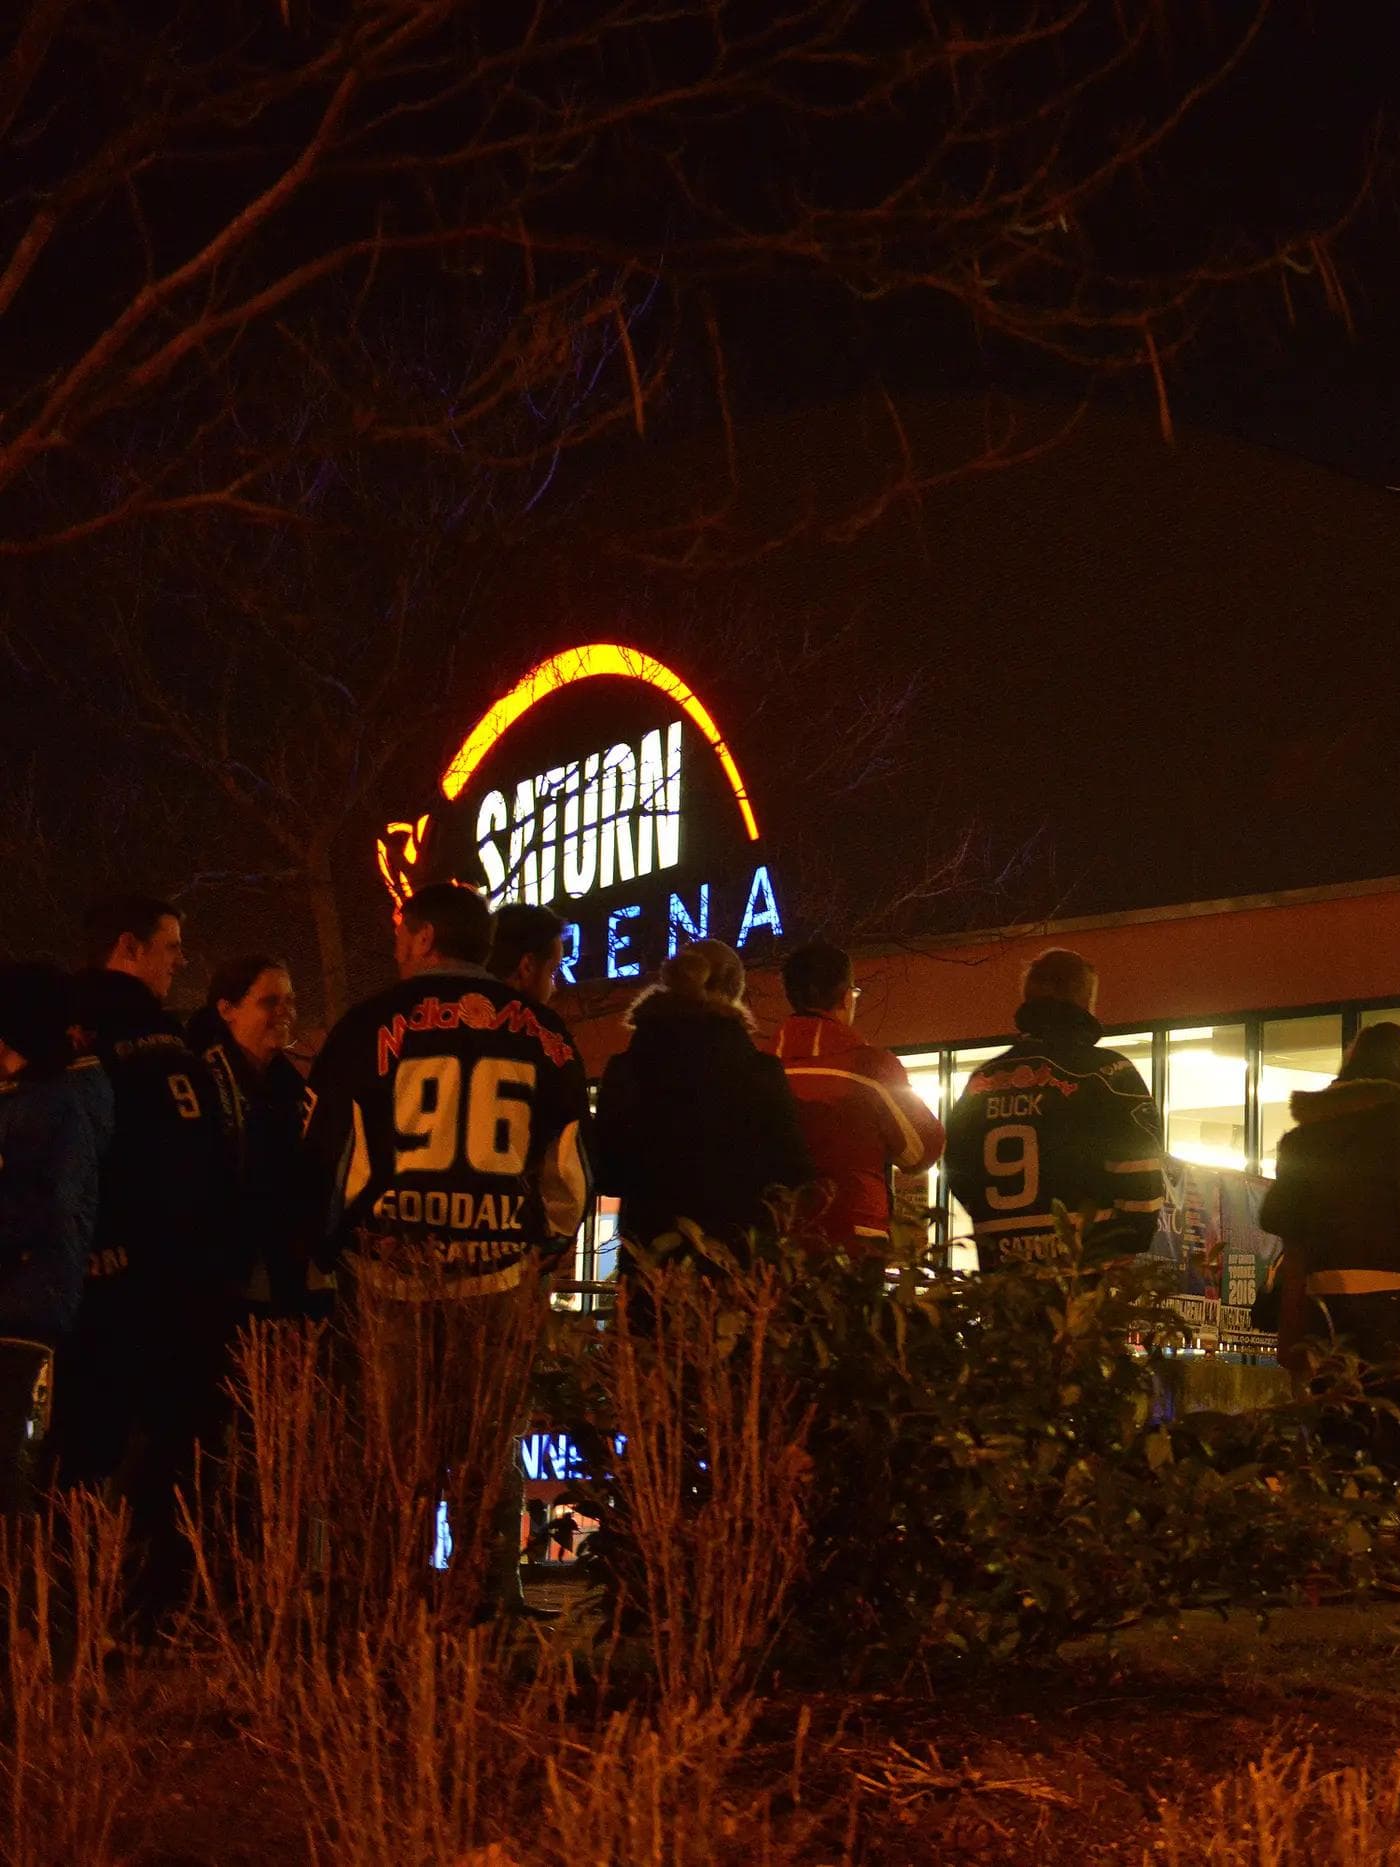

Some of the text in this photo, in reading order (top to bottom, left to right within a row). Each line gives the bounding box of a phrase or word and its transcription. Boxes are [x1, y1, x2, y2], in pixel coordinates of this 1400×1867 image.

[476, 721, 682, 914] SATURN
[559, 866, 784, 985] RENA
[167, 1071, 201, 1120] 9
[393, 1054, 538, 1176] 96
[985, 1094, 1044, 1120] BUCK
[982, 1123, 1041, 1212] 9
